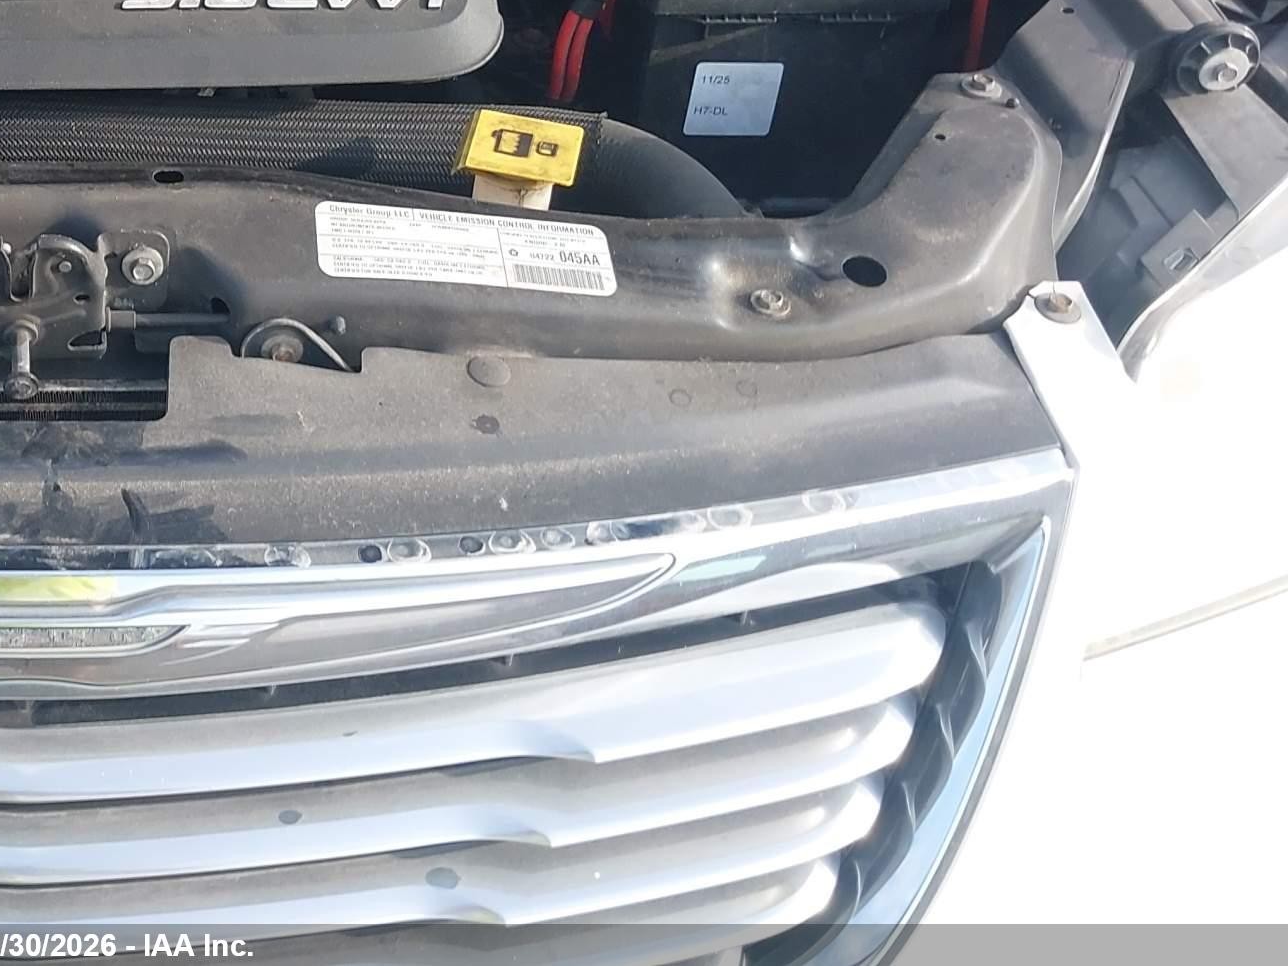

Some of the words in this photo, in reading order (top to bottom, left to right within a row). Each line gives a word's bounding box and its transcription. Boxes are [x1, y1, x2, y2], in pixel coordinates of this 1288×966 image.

[702, 75, 730, 84] 11/25
[693, 105, 728, 116] H7-DL
[366, 207, 390, 218] Group
[419, 212, 452, 222] VEHICLE
[456, 216, 495, 226] EMISSION
[497, 219, 532, 230] CONTROL
[537, 223, 594, 236] INFORMATION
[559, 249, 600, 266] 045AA
